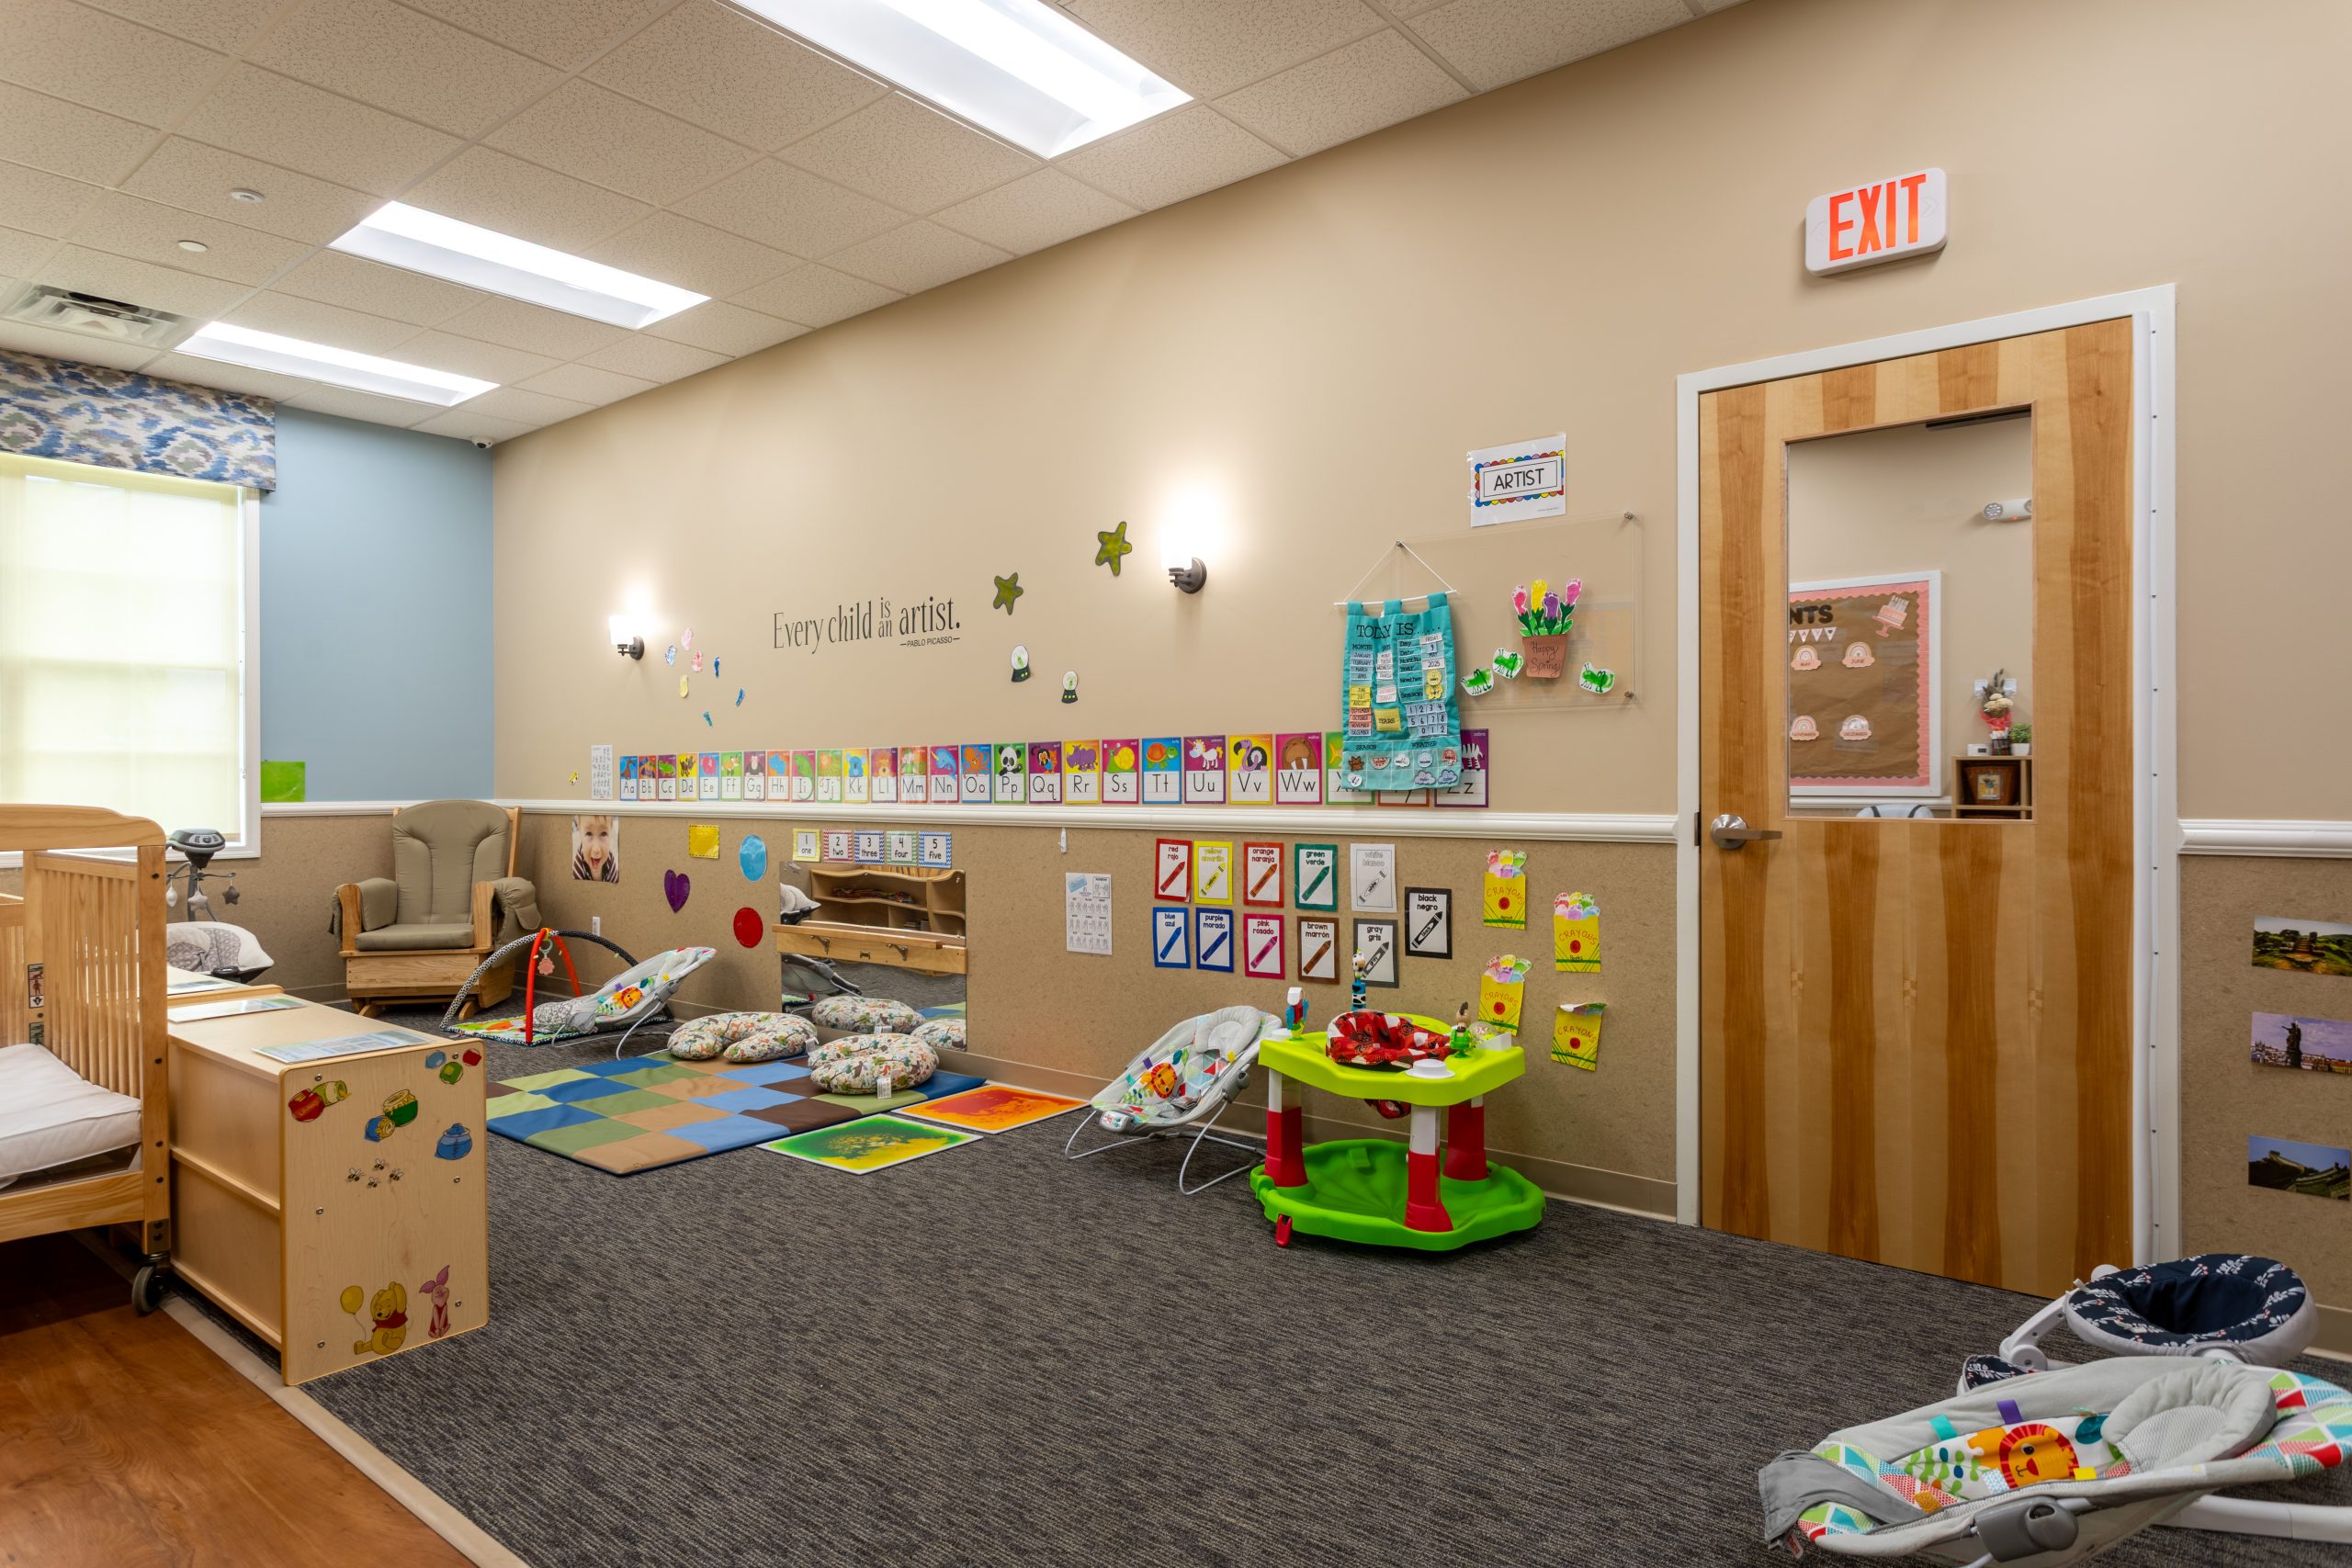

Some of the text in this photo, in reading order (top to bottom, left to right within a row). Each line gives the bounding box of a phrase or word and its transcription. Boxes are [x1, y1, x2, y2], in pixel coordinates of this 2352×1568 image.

[1829, 173, 1927, 262] EXIT
[1494, 468, 1544, 491] ARTIST
[774, 596, 960, 654] Every child is an artist.
[1530, 641, 1558, 660] Happy
[1529, 657, 1561, 678] Spring
[623, 779, 635, 794] Aa
[662, 779, 673, 793] Cc
[681, 778, 694, 793] Dd
[703, 778, 714, 793] Ee
[726, 778, 736, 793] Ff
[746, 777, 762, 799] Gg
[771, 778, 785, 793] Hh
[824, 778, 834, 801] Jj
[849, 777, 863, 794] Kk
[902, 776, 924, 794] Mm
[935, 776, 953, 794] Nn
[966, 776, 986, 793] Oo
[1001, 775, 1018, 801] Pp
[1032, 775, 1057, 801] Qq
[1073, 774, 1090, 793] Rr
[1111, 773, 1127, 793] Ss
[1152, 773, 1169, 793] Tt
[1193, 773, 1216, 792] Uu
[1238, 773, 1261, 793] Vv
[1280, 772, 1317, 792] Ww
[835, 836, 841, 846] 2
[867, 837, 872, 848] 3
[899, 837, 904, 849] 4
[933, 838, 938, 850] 5
[801, 846, 812, 854] one
[832, 847, 843, 856] two
[861, 848, 877, 857] three
[895, 849, 909, 858] four
[929, 850, 942, 860] five
[1204, 848, 1223, 856] yellow
[1252, 848, 1274, 856] orange
[1306, 851, 1326, 859] green
[1364, 851, 1384, 859] white
[1306, 858, 1325, 866] verde
[1418, 894, 1437, 902] black
[1487, 886, 1525, 906] CRAYONS
[1417, 902, 1438, 911] negro
[1204, 914, 1224, 922] purple
[1306, 921, 1329, 931] brown
[1366, 926, 1384, 935] gray
[1368, 933, 1382, 942] gris
[1558, 929, 1598, 945] CRAYONS
[1484, 991, 1519, 1007] CRAYONS
[1557, 1025, 1597, 1043] CRAYONS
